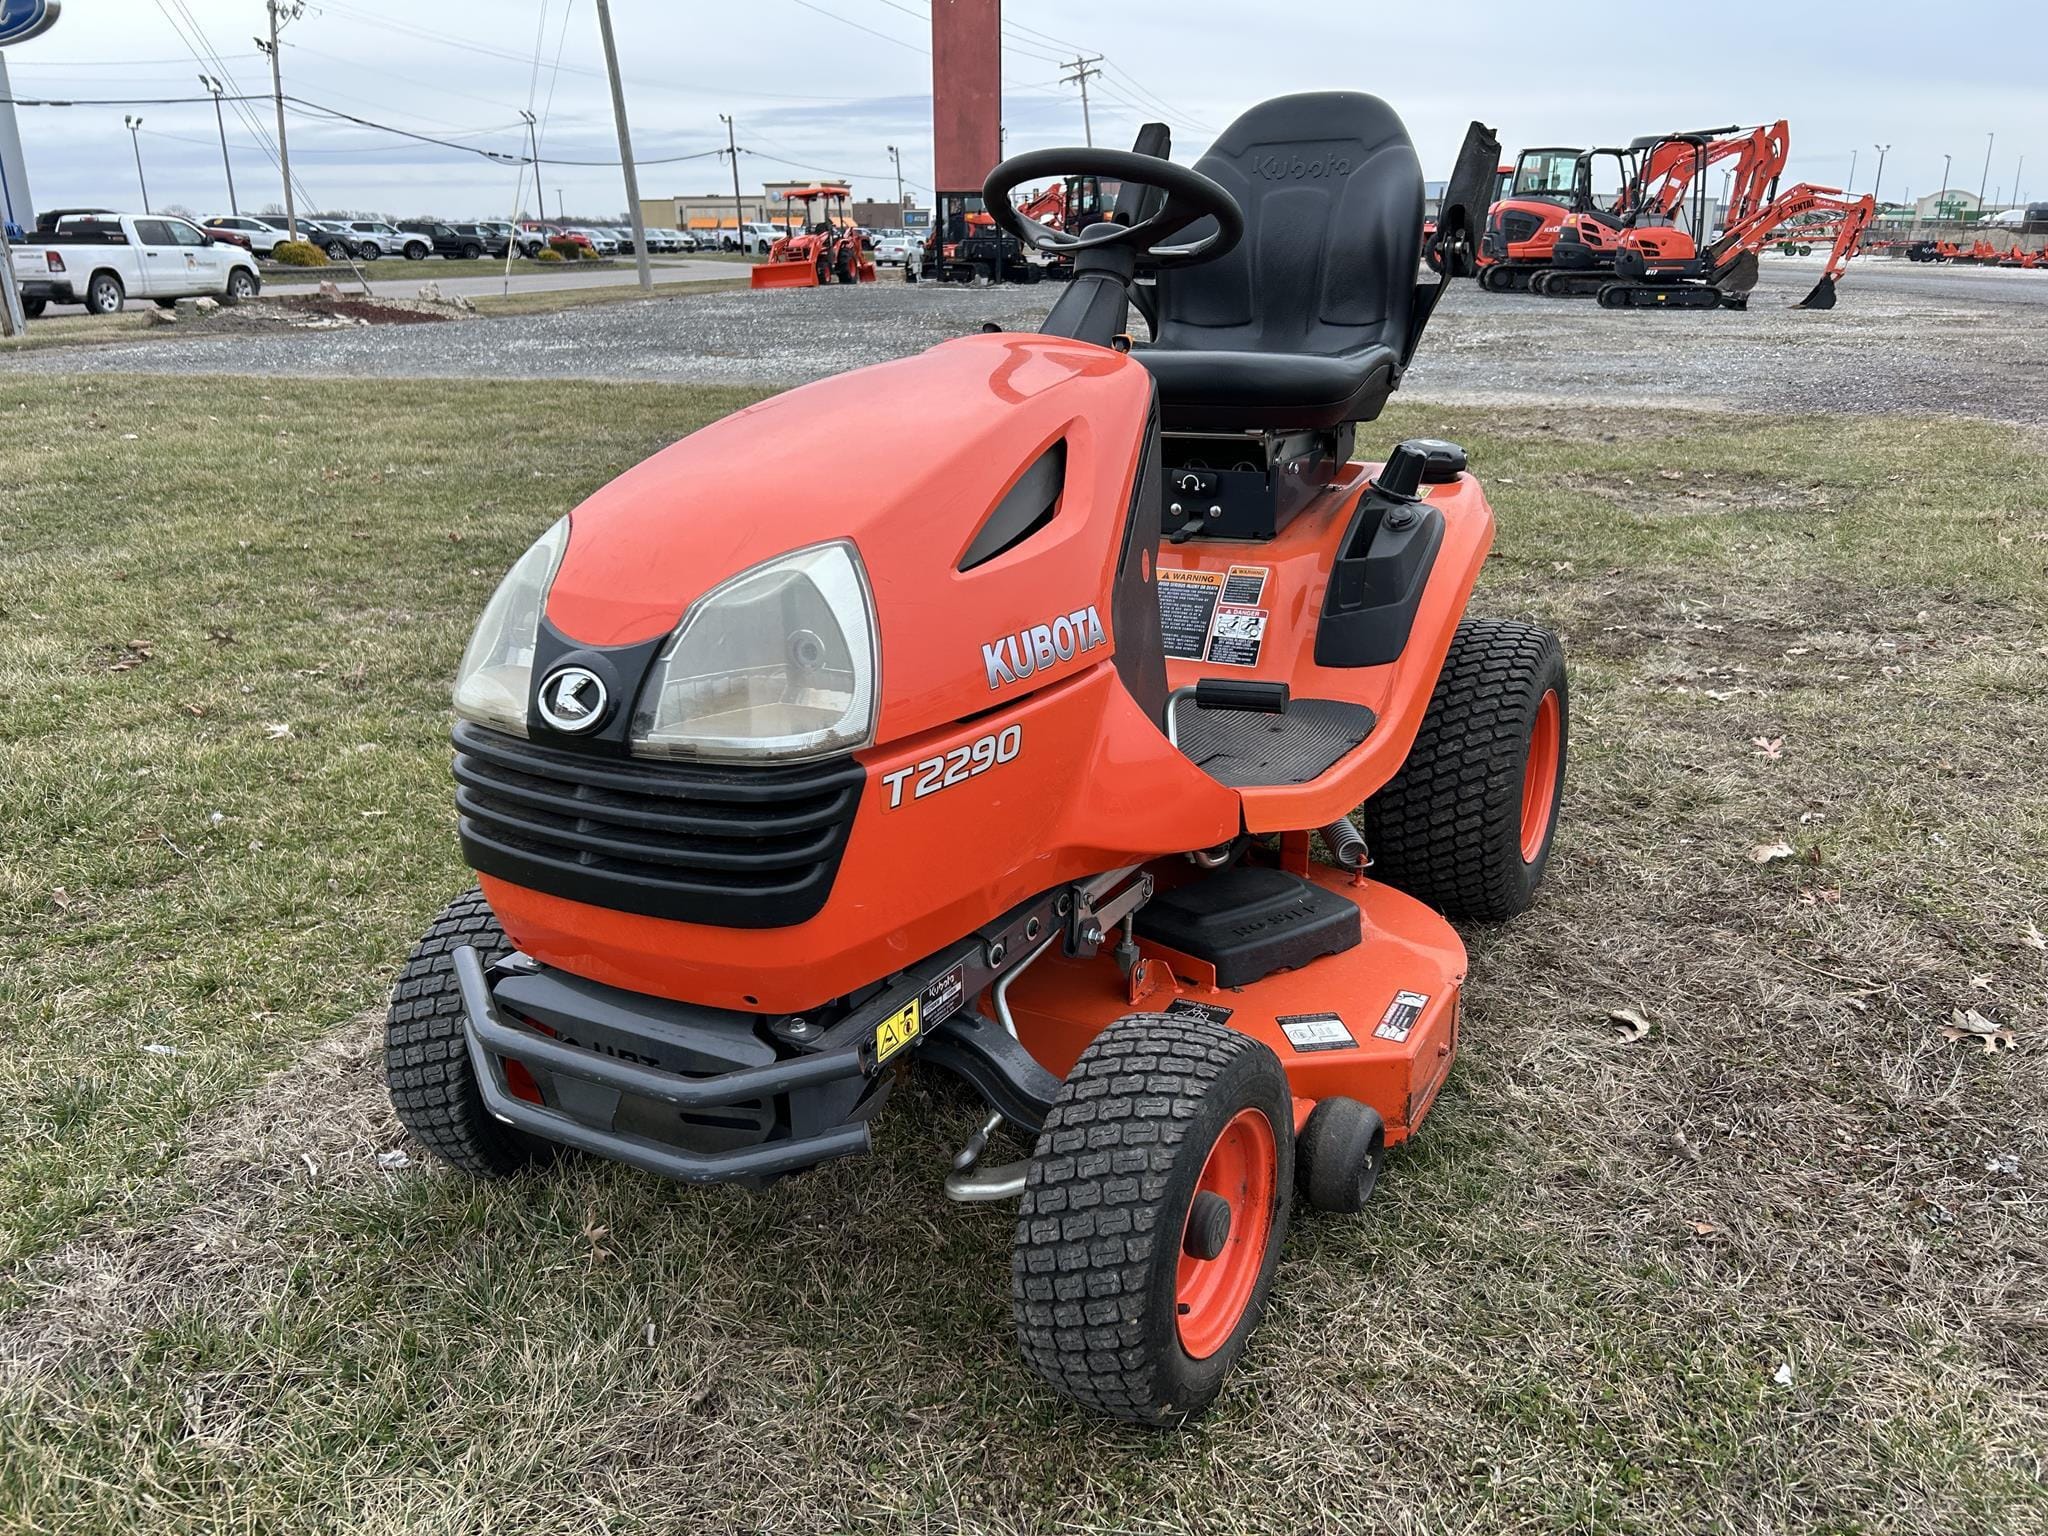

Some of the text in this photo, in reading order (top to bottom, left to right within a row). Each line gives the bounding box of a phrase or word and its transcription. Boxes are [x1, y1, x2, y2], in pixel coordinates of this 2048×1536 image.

[1252, 152, 1350, 180] Kubota
[1172, 573, 1215, 583] WARNING
[1233, 609, 1260, 617] DANGER
[981, 605, 1107, 690] KUBOTA
[882, 723, 1022, 810] T2290
[929, 974, 955, 997] Kubota
